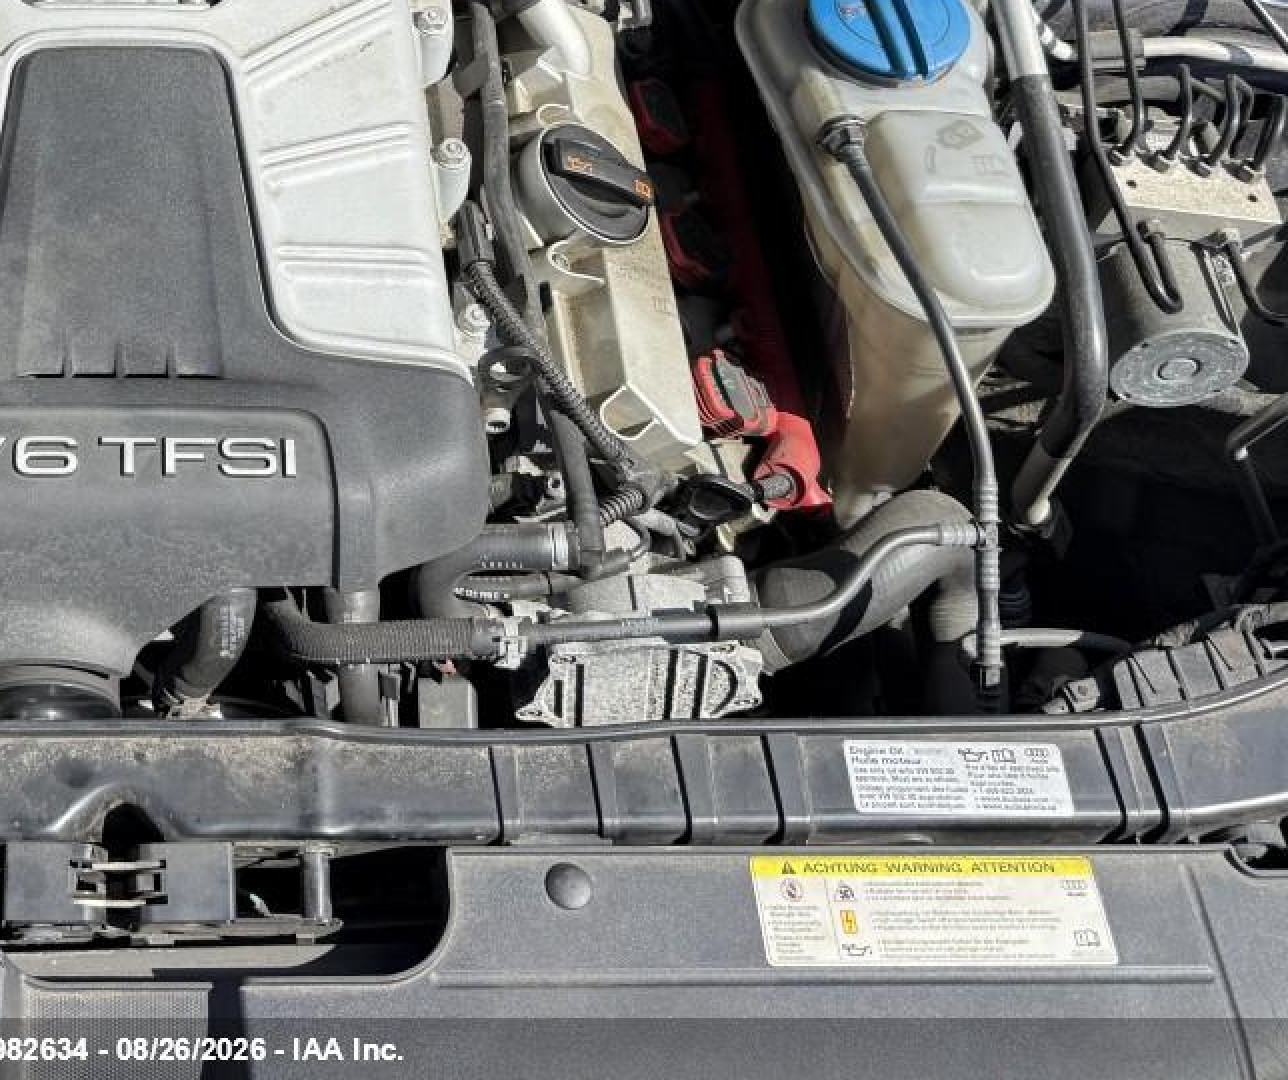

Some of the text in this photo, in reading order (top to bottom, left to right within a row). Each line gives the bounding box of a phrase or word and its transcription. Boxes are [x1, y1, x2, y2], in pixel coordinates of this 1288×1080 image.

[98, 435, 297, 477] TFSI
[803, 862, 1055, 874] ACHTUNG WARNING ATTENTION
